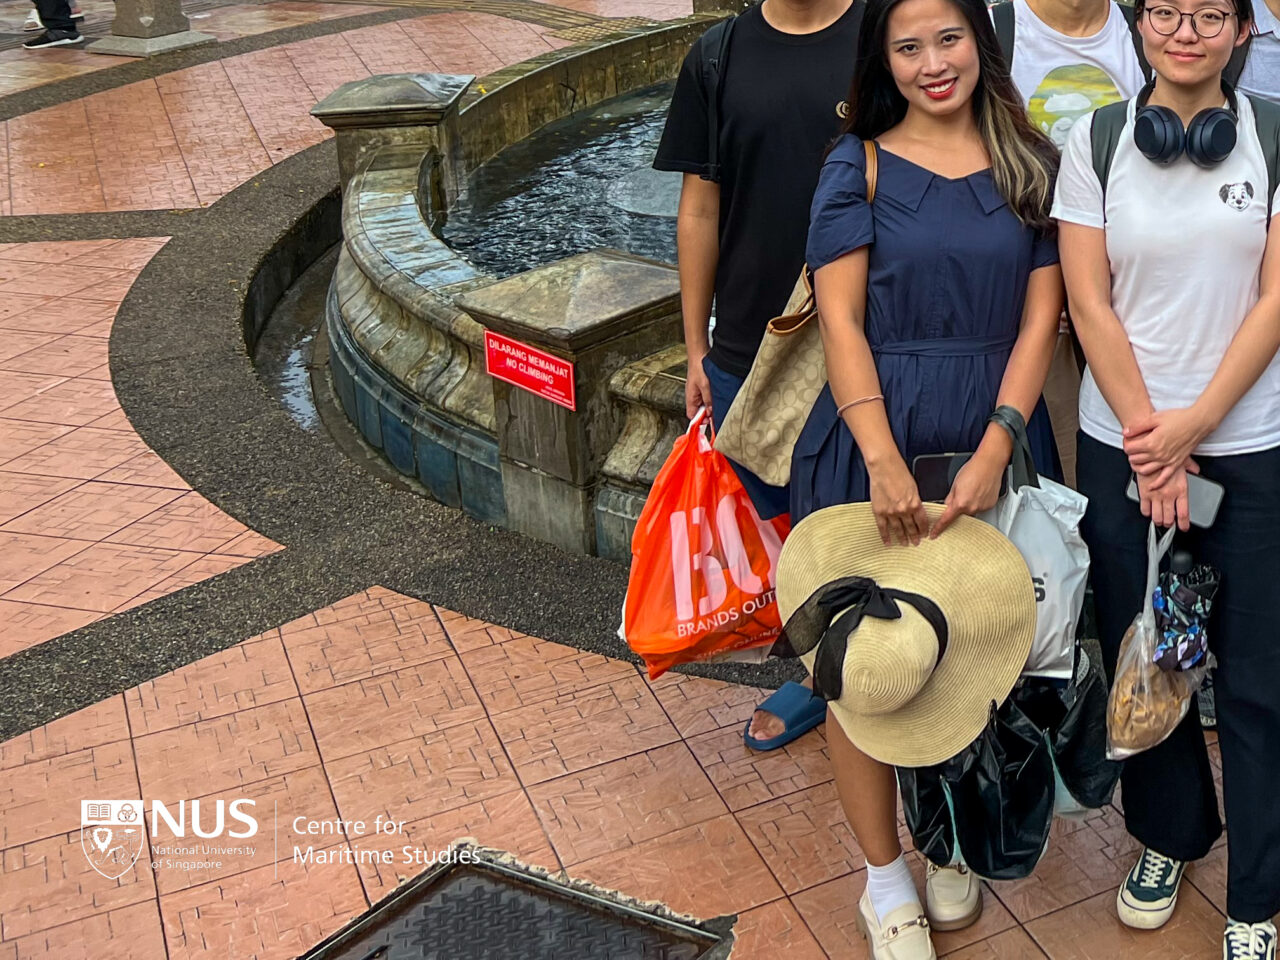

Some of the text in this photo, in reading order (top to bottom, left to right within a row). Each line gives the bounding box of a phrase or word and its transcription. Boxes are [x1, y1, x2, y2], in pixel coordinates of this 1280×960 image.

[489, 338, 568, 378] DILARANG MEMANJAT
[506, 357, 554, 385] NO CLIMBING
[677, 590, 777, 638] BRANDS OUT
